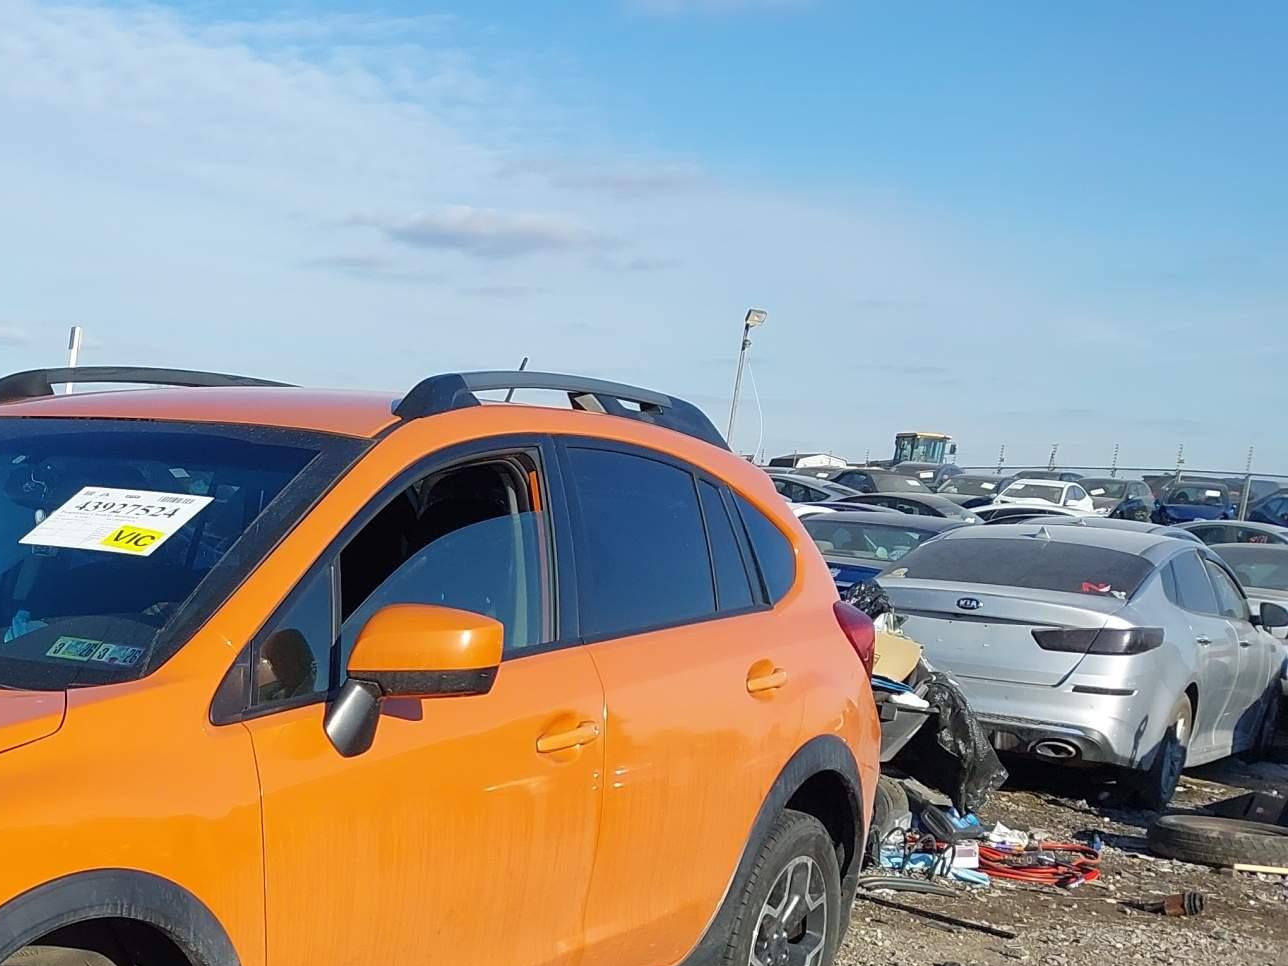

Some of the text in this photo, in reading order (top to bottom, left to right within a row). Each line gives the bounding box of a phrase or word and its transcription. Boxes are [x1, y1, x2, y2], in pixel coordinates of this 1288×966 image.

[75, 500, 180, 518] 43927524
[113, 529, 156, 547] VIC
[959, 599, 977, 609] KIA
